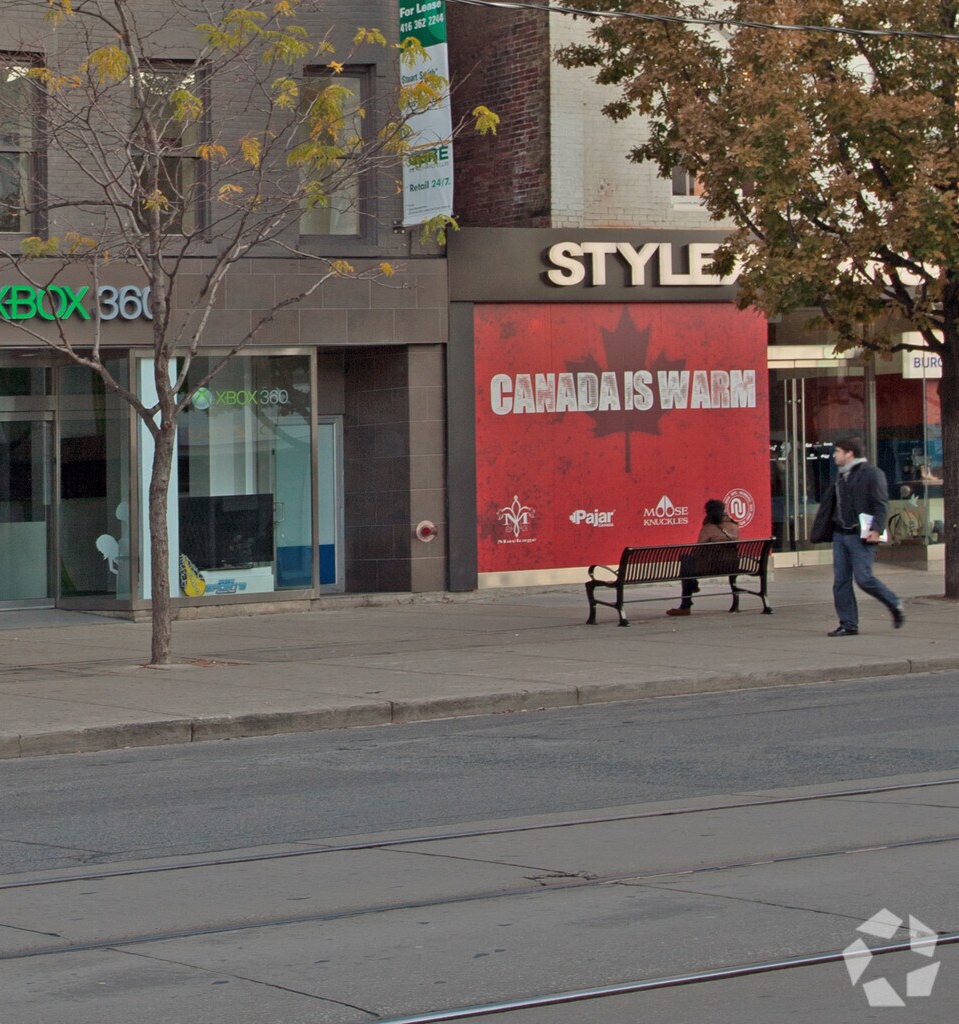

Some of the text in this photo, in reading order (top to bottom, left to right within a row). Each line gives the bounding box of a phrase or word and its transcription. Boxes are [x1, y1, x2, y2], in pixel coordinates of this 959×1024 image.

[399, 0, 442, 18] For Lease
[399, 21, 413, 33] 416
[409, 180, 429, 192] Retail
[215, 389, 288, 406] XBOX 360
[490, 369, 757, 416] CANADA IS WARM
[576, 509, 614, 527] Pajar
[644, 504, 689, 517] MOOSE
[643, 517, 689, 526] KNUCKLES
